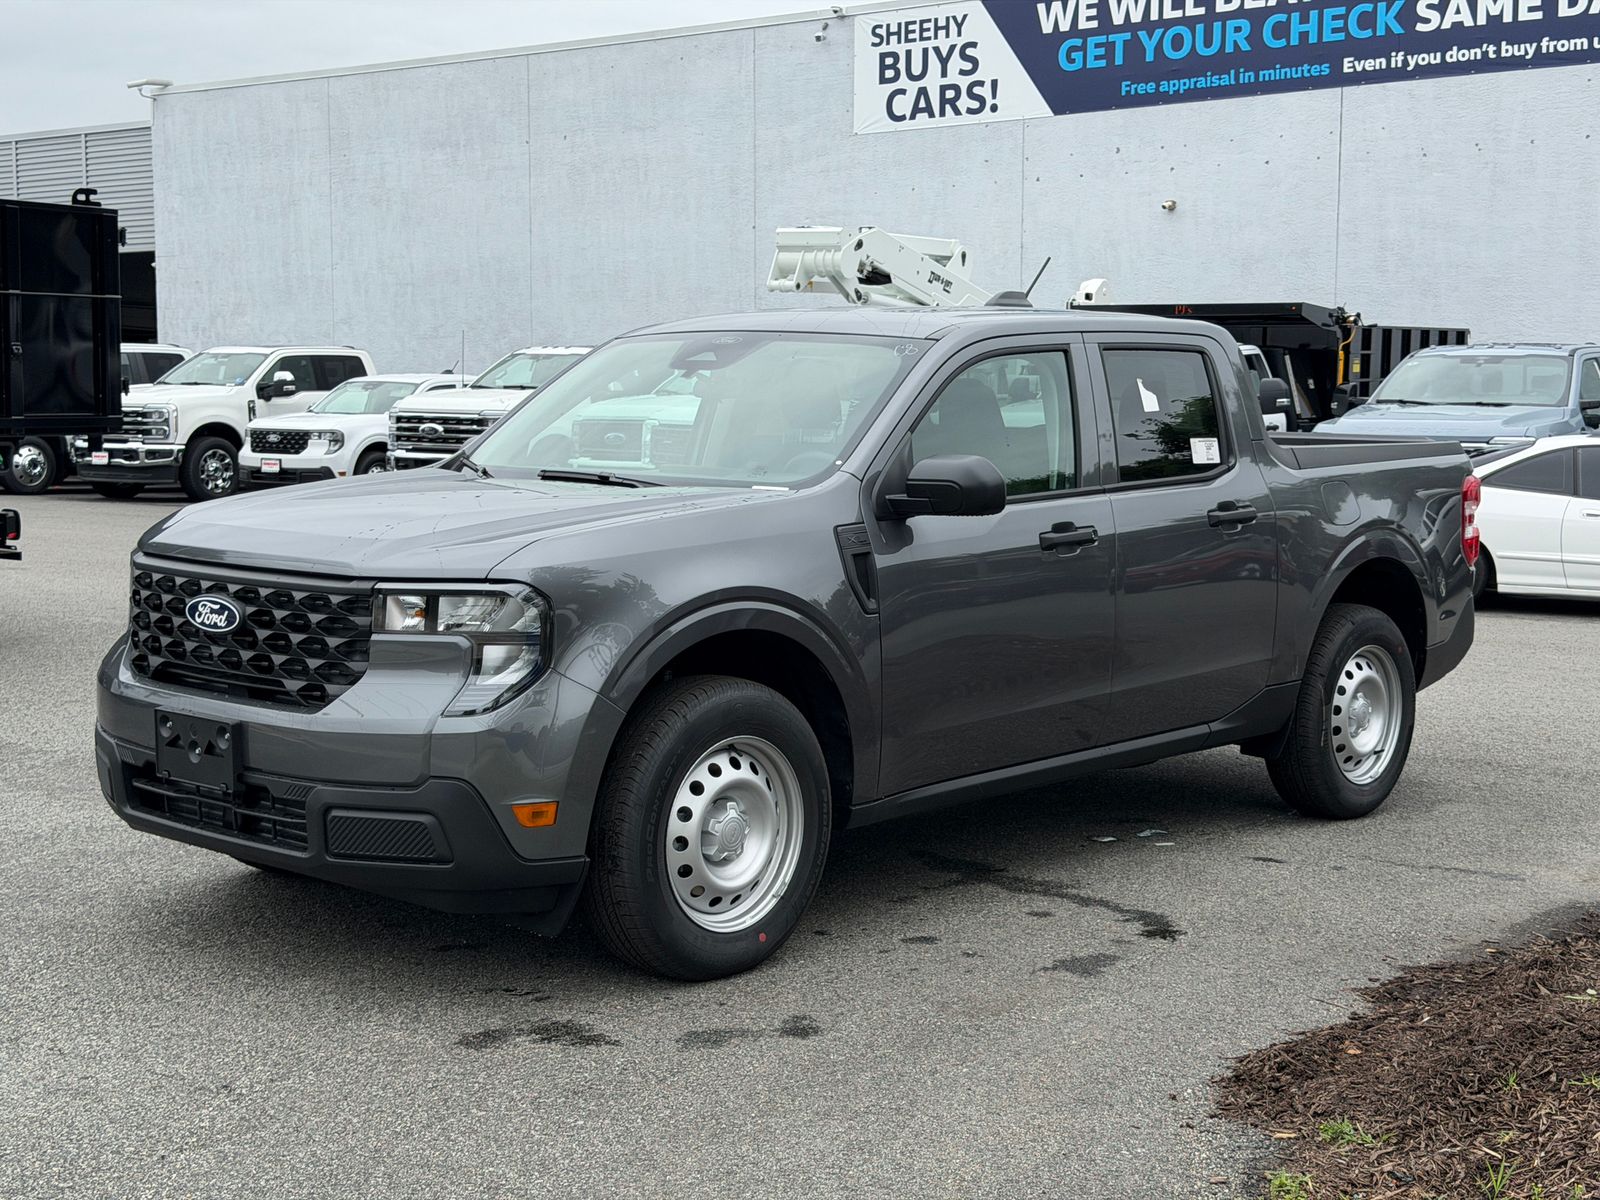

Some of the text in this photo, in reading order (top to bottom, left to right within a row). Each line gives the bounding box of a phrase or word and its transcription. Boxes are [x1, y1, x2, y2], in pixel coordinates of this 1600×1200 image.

[871, 14, 968, 47] SHEEHY
[1037, 0, 1098, 34] WE
[1058, 32, 1131, 71] GET
[1137, 19, 1252, 62] YOUR
[1263, 0, 1405, 48] CHECK
[1415, 0, 1543, 32] SAME
[879, 41, 980, 85] BUYS
[1343, 57, 1386, 73] Even
[1391, 51, 1404, 68] if
[1406, 52, 1441, 71] you
[1445, 43, 1497, 63] don't
[1500, 40, 1538, 60] buy
[1540, 36, 1588, 53] from
[1121, 63, 1330, 96] Free appraisal in minutes
[886, 79, 998, 122] CARS!
[193, 600, 230, 628] Ford
